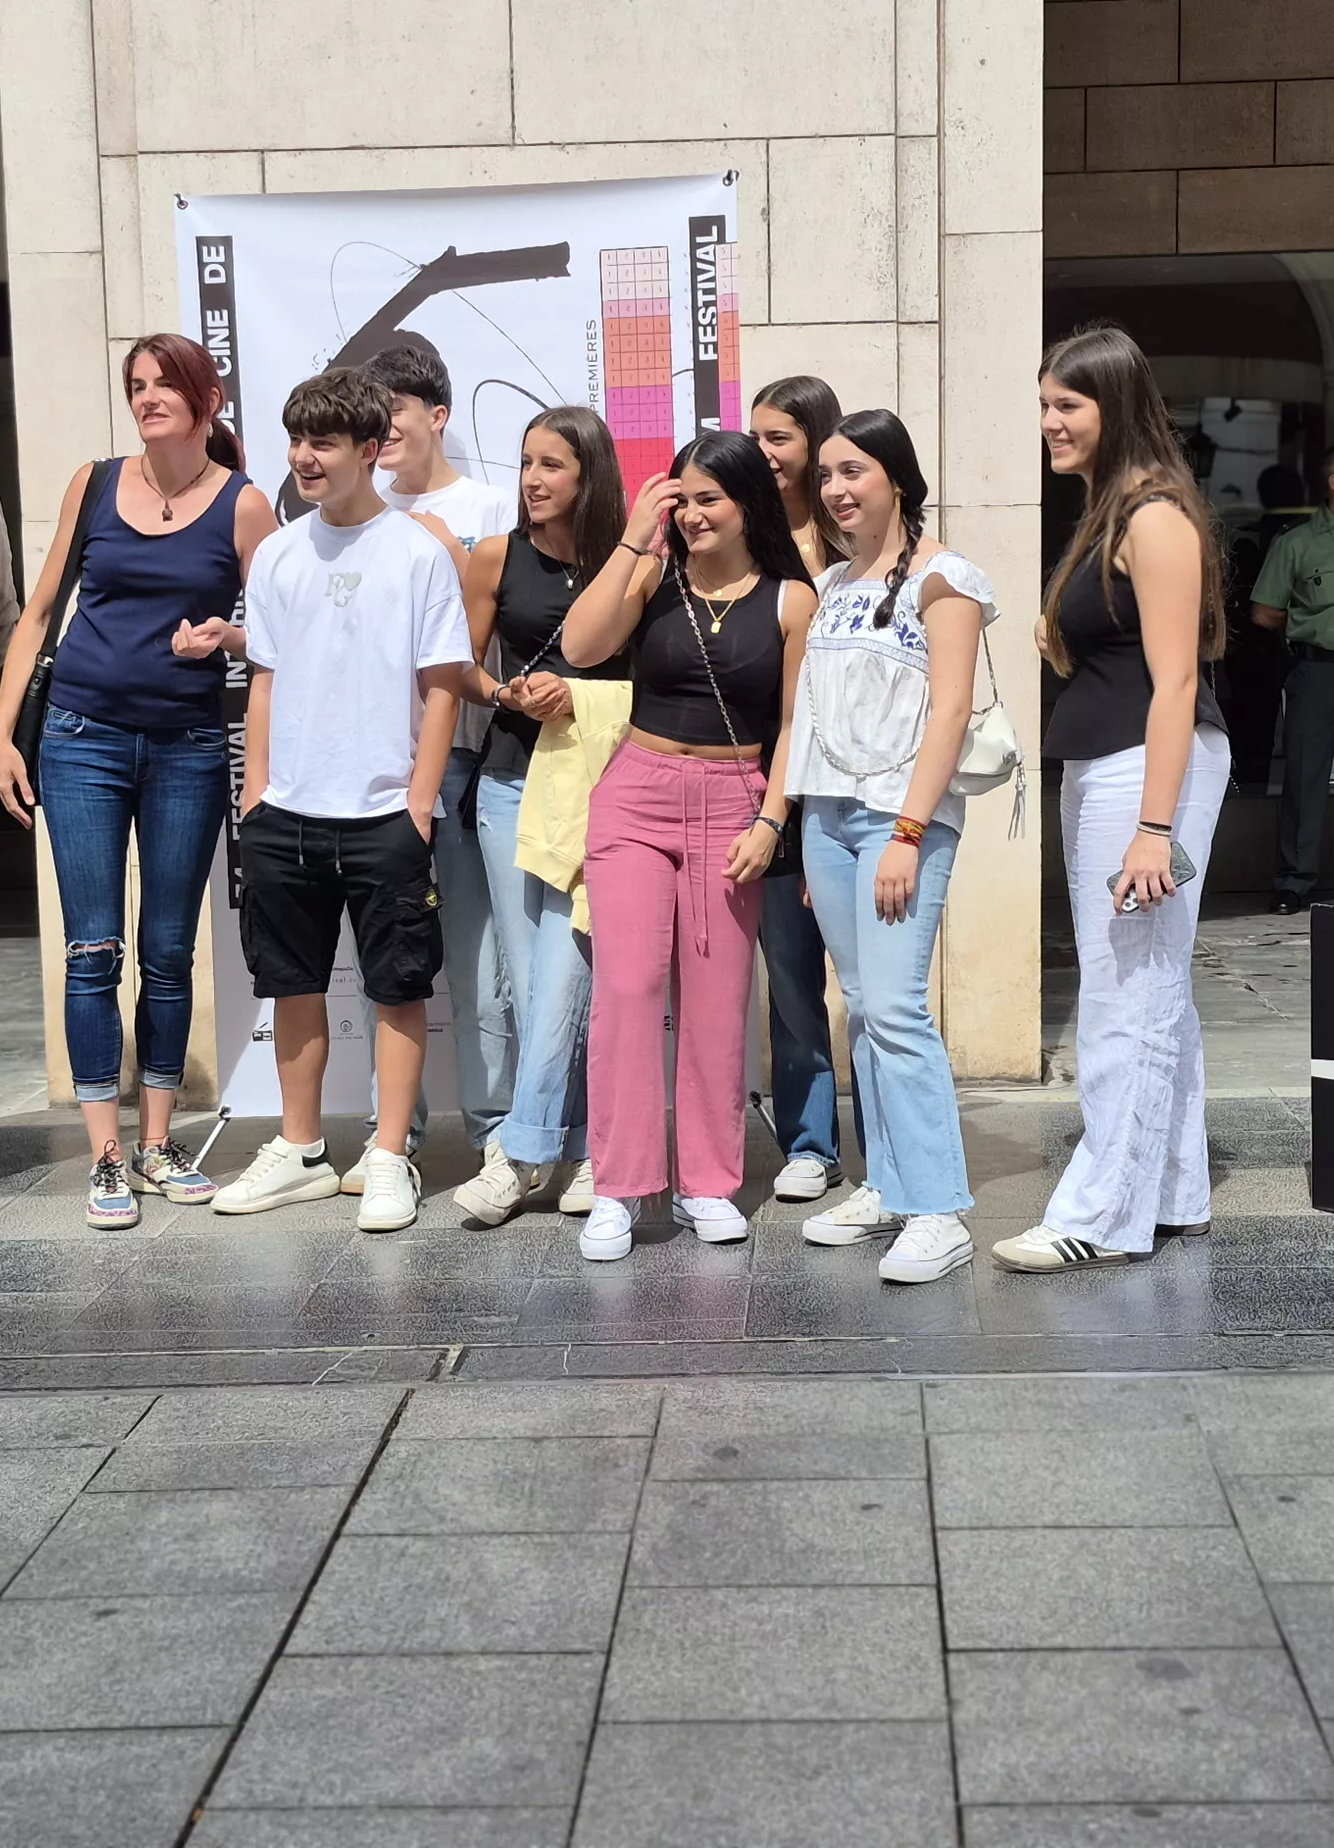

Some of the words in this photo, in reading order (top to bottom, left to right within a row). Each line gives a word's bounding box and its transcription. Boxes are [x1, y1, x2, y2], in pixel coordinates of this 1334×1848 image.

[201, 245, 227, 285] DE
[695, 224, 719, 362] FESTIVAL
[206, 308, 233, 378] CINE
